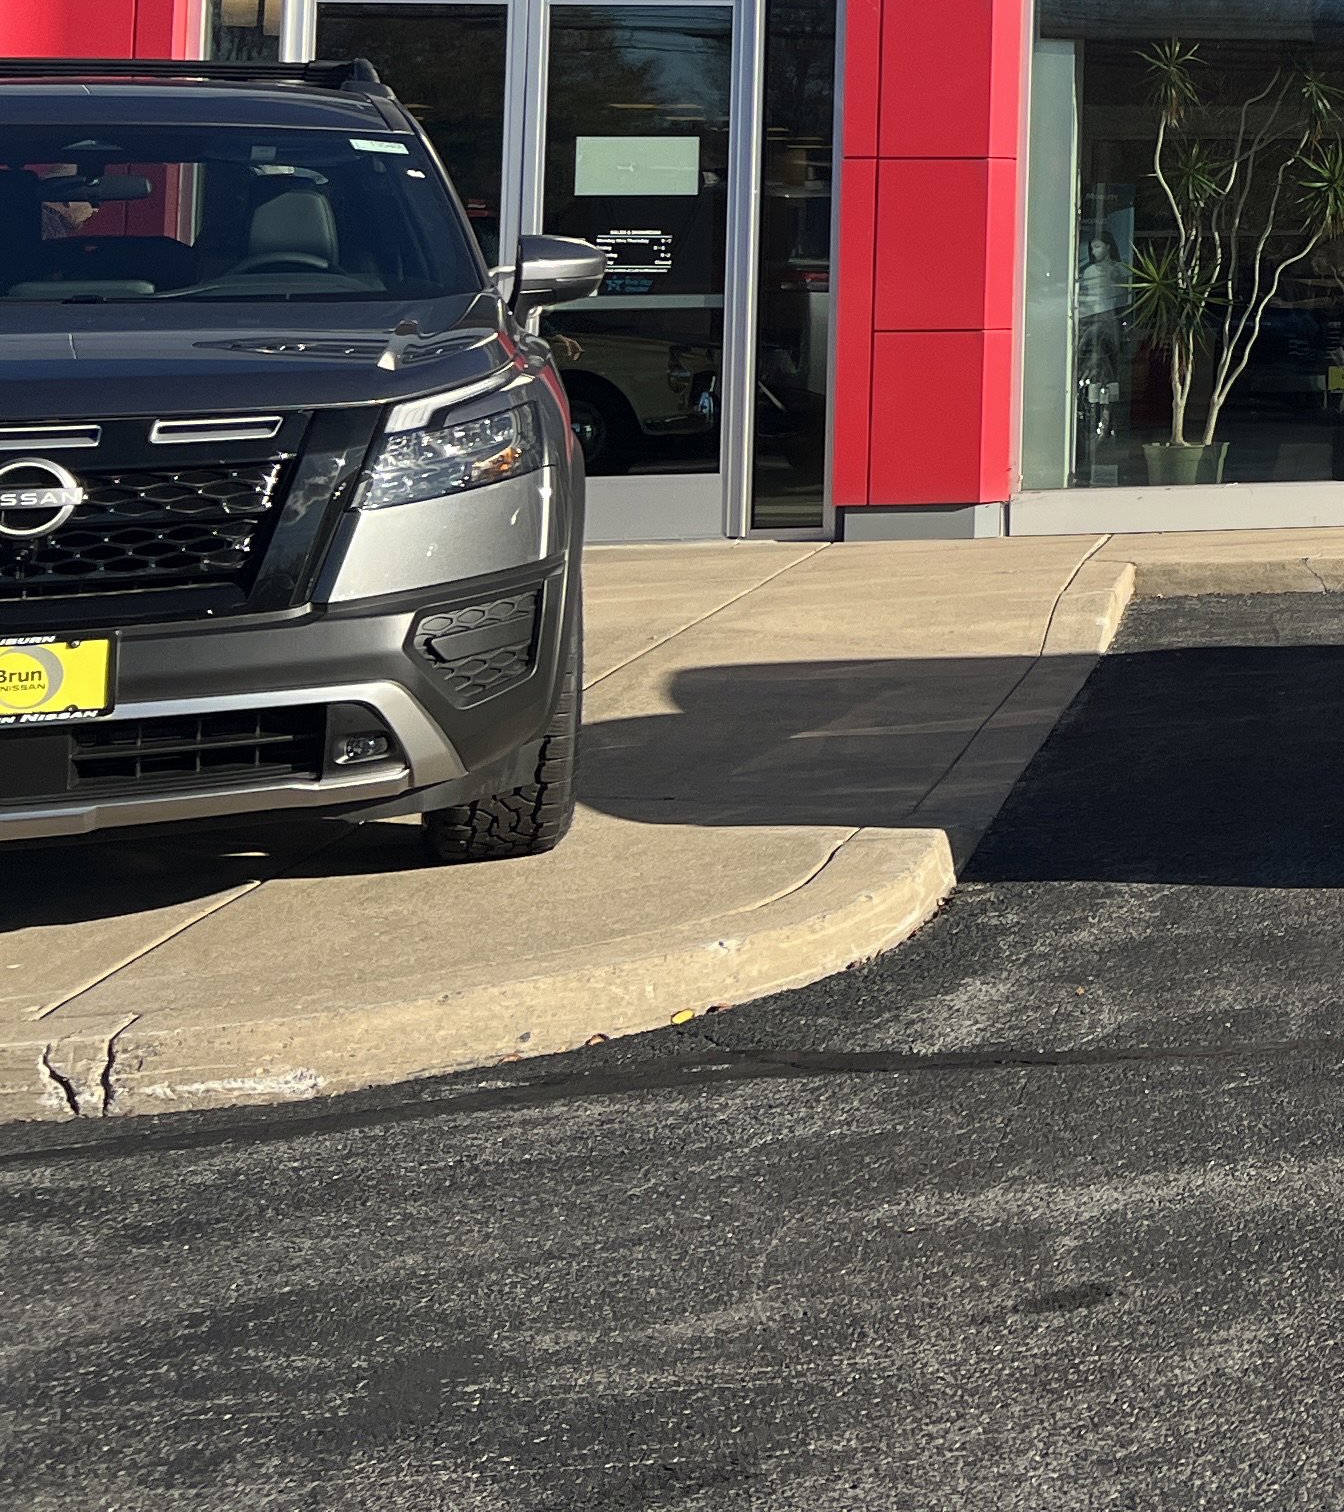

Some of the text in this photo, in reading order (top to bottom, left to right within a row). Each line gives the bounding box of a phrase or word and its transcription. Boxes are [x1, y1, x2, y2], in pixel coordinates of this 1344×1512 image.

[0, 491, 79, 507] SSAN
[0, 636, 56, 646] BURN
[0, 669, 42, 683] Brun
